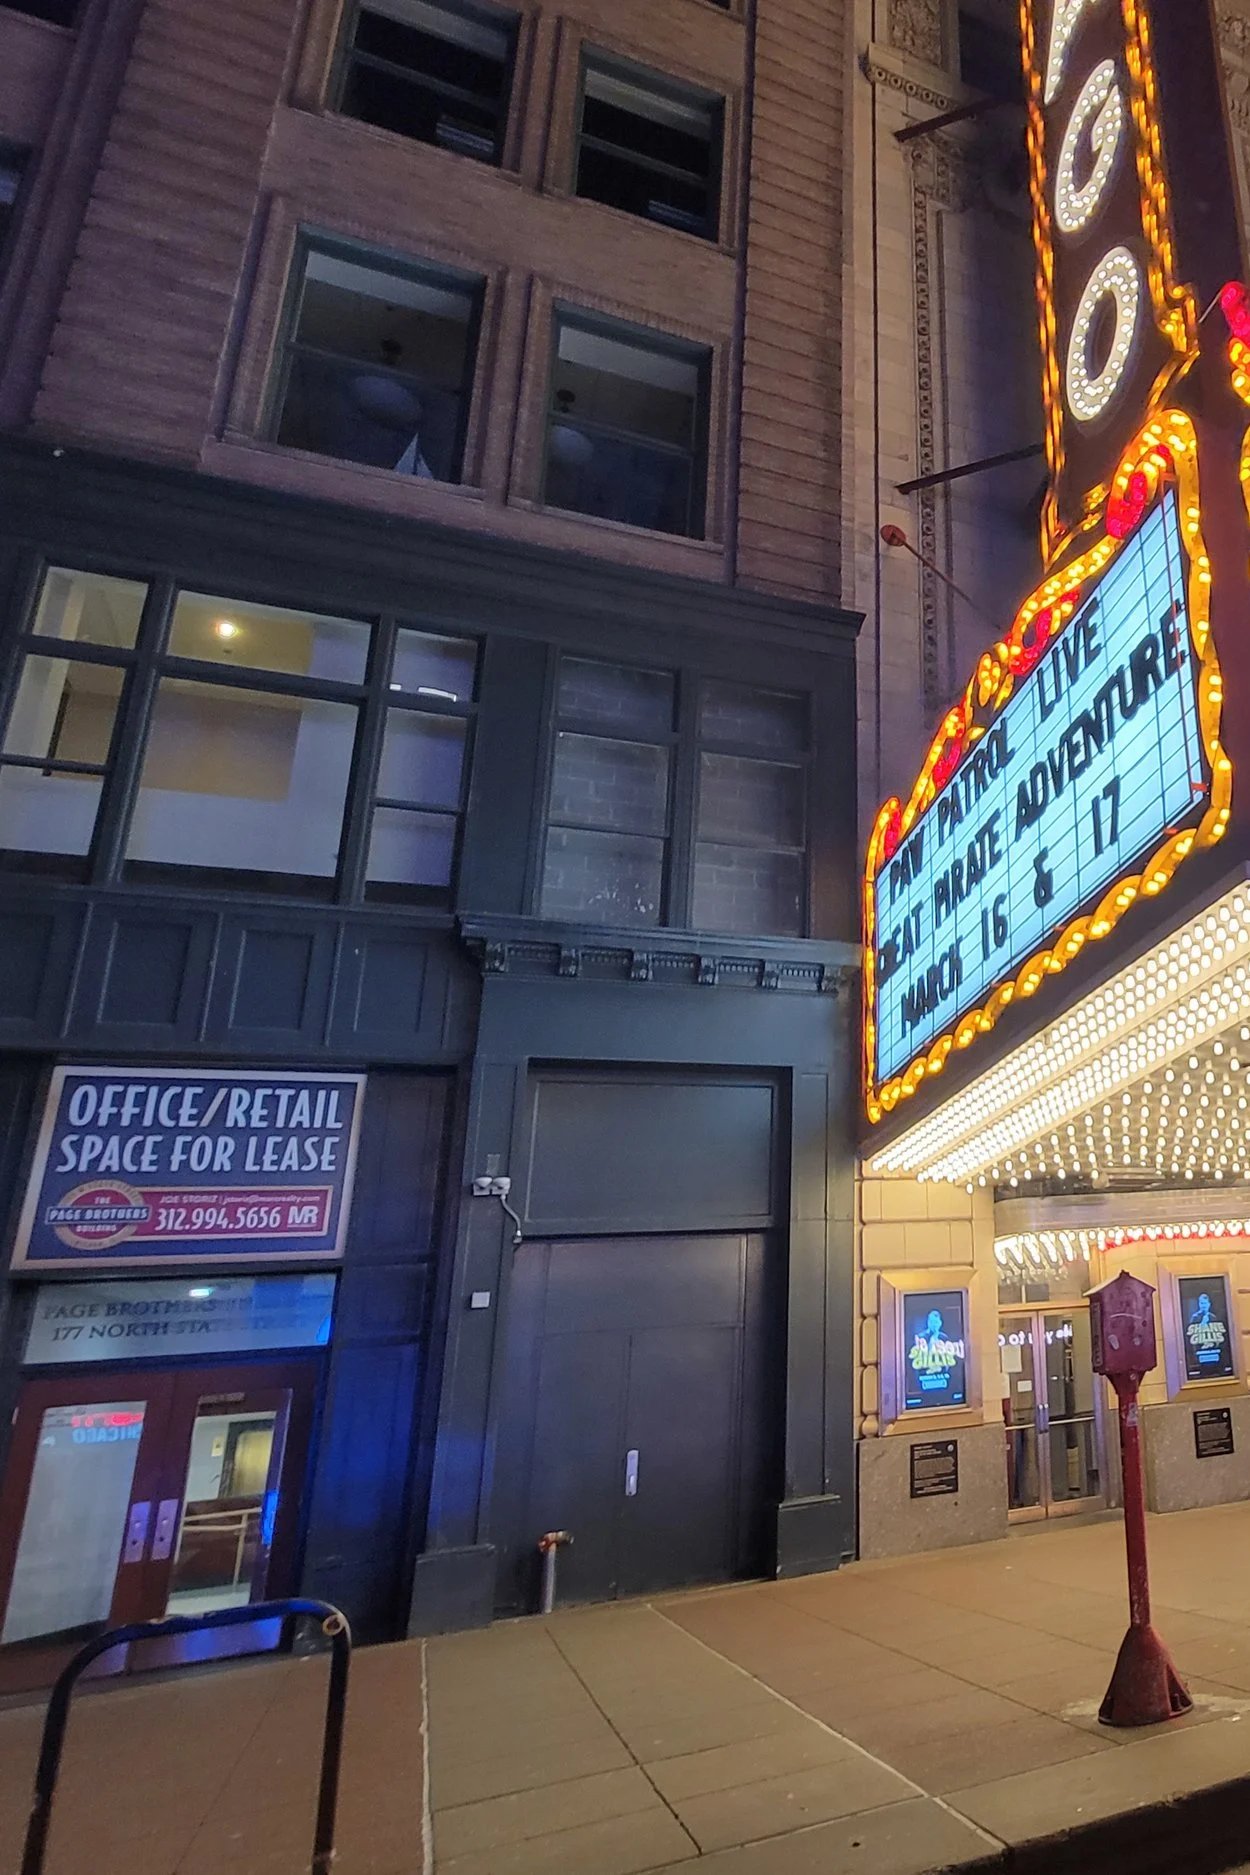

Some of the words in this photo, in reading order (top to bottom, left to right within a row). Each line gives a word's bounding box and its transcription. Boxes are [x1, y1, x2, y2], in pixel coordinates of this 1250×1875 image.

[889, 824, 925, 906] PAW
[937, 716, 1015, 848] PATROL
[1037, 596, 1102, 723] LIVE
[933, 807, 1001, 930] PIRATE
[901, 934, 964, 1039] MARCH
[981, 892, 1008, 962] 16
[1033, 845, 1054, 909] &
[1091, 774, 1121, 859] 17
[67, 1083, 344, 1129] OFFICE/RETAIL
[55, 1133, 163, 1173] SPACE
[169, 1134, 236, 1173] FOR
[244, 1135, 340, 1172] LEASE
[49, 1208, 81, 1221] PAGE
[84, 1207, 148, 1220] BROTHERS
[155, 1206, 281, 1232] 312.994.5656
[51, 1325, 85, 1341] 177
[87, 1318, 169, 1340] NORTH
[1186, 1321, 1226, 1336] SHANE
[1189, 1332, 1225, 1346] GILLIS
